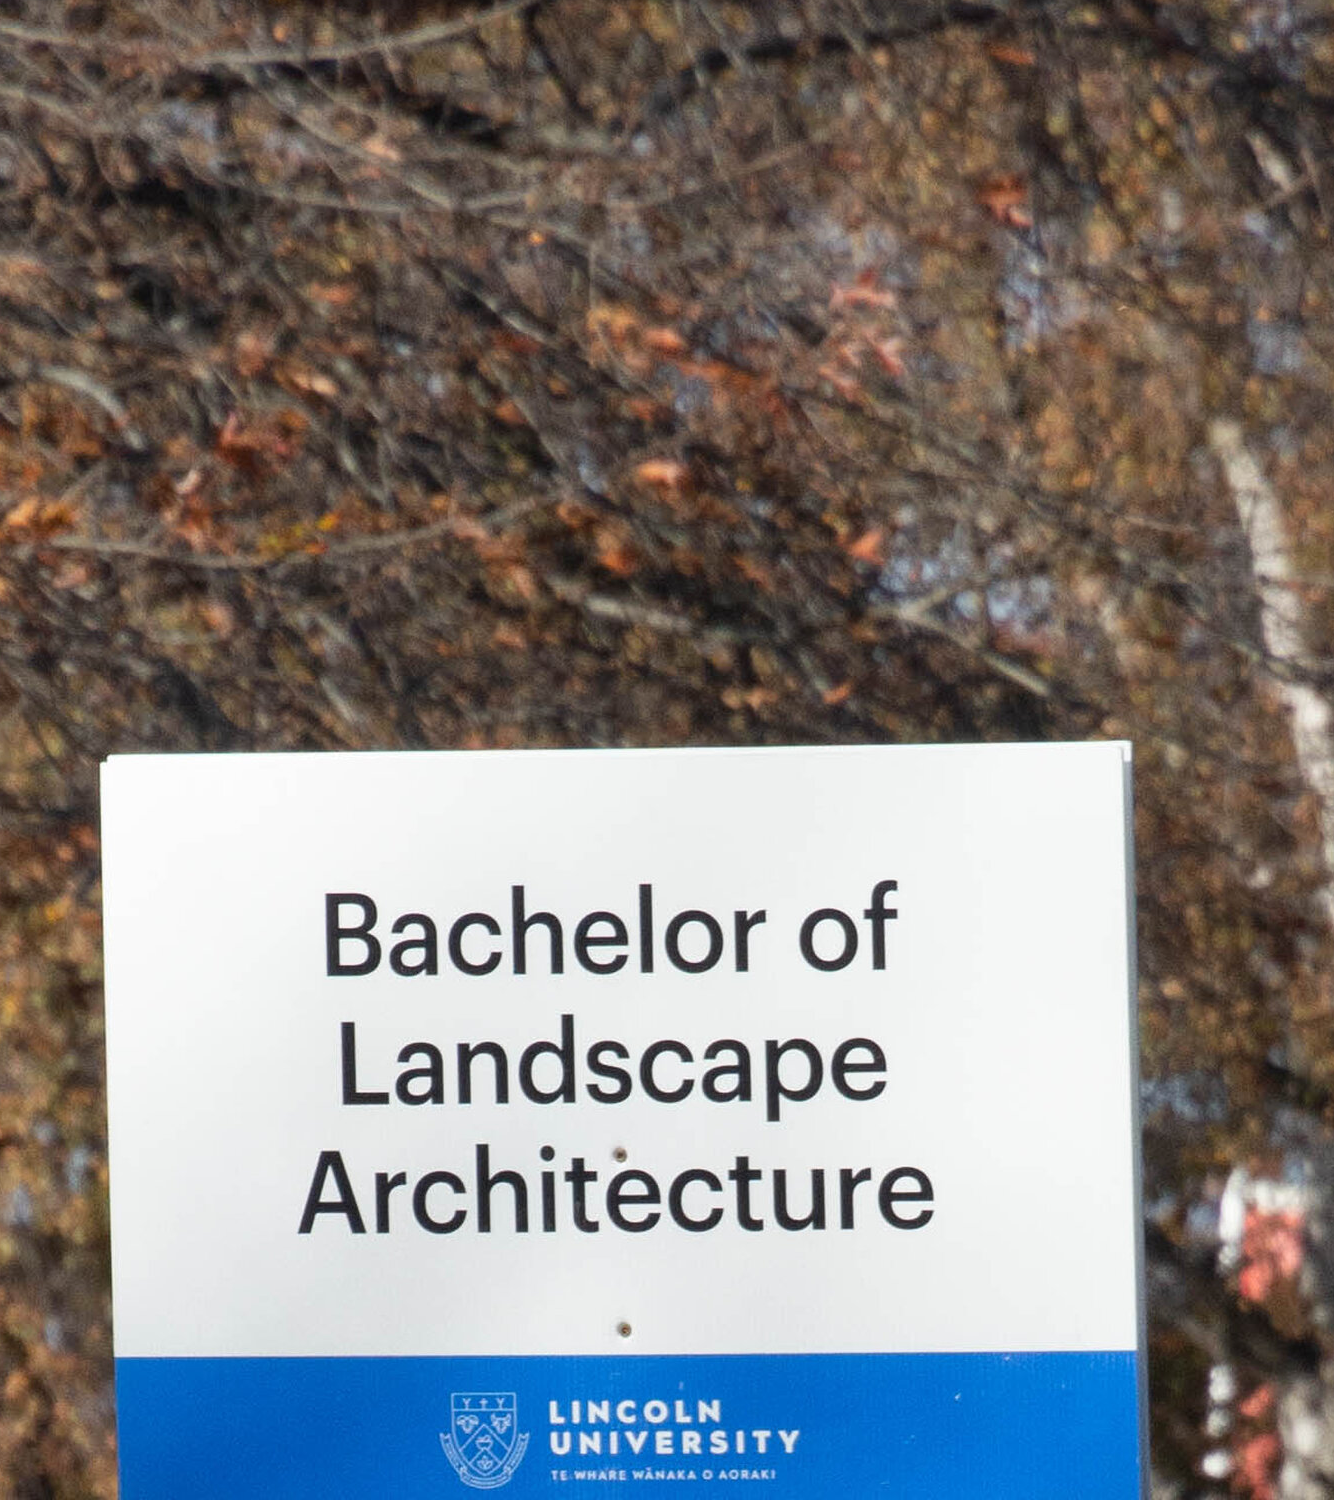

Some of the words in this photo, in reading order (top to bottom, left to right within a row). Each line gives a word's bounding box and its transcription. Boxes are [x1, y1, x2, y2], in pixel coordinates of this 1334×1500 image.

[325, 883, 767, 977] Bachelor
[799, 879, 898, 972] of
[341, 1013, 887, 1122] Landscape
[297, 1143, 934, 1235] Architecture
[549, 1399, 721, 1425] LINCOLN
[549, 1429, 800, 1456] UNIVERSITY
[551, 1470, 568, 1482] TE
[574, 1469, 627, 1482] WHARE
[702, 1469, 713, 1481] O
[718, 1468, 776, 1481] AORAKI
